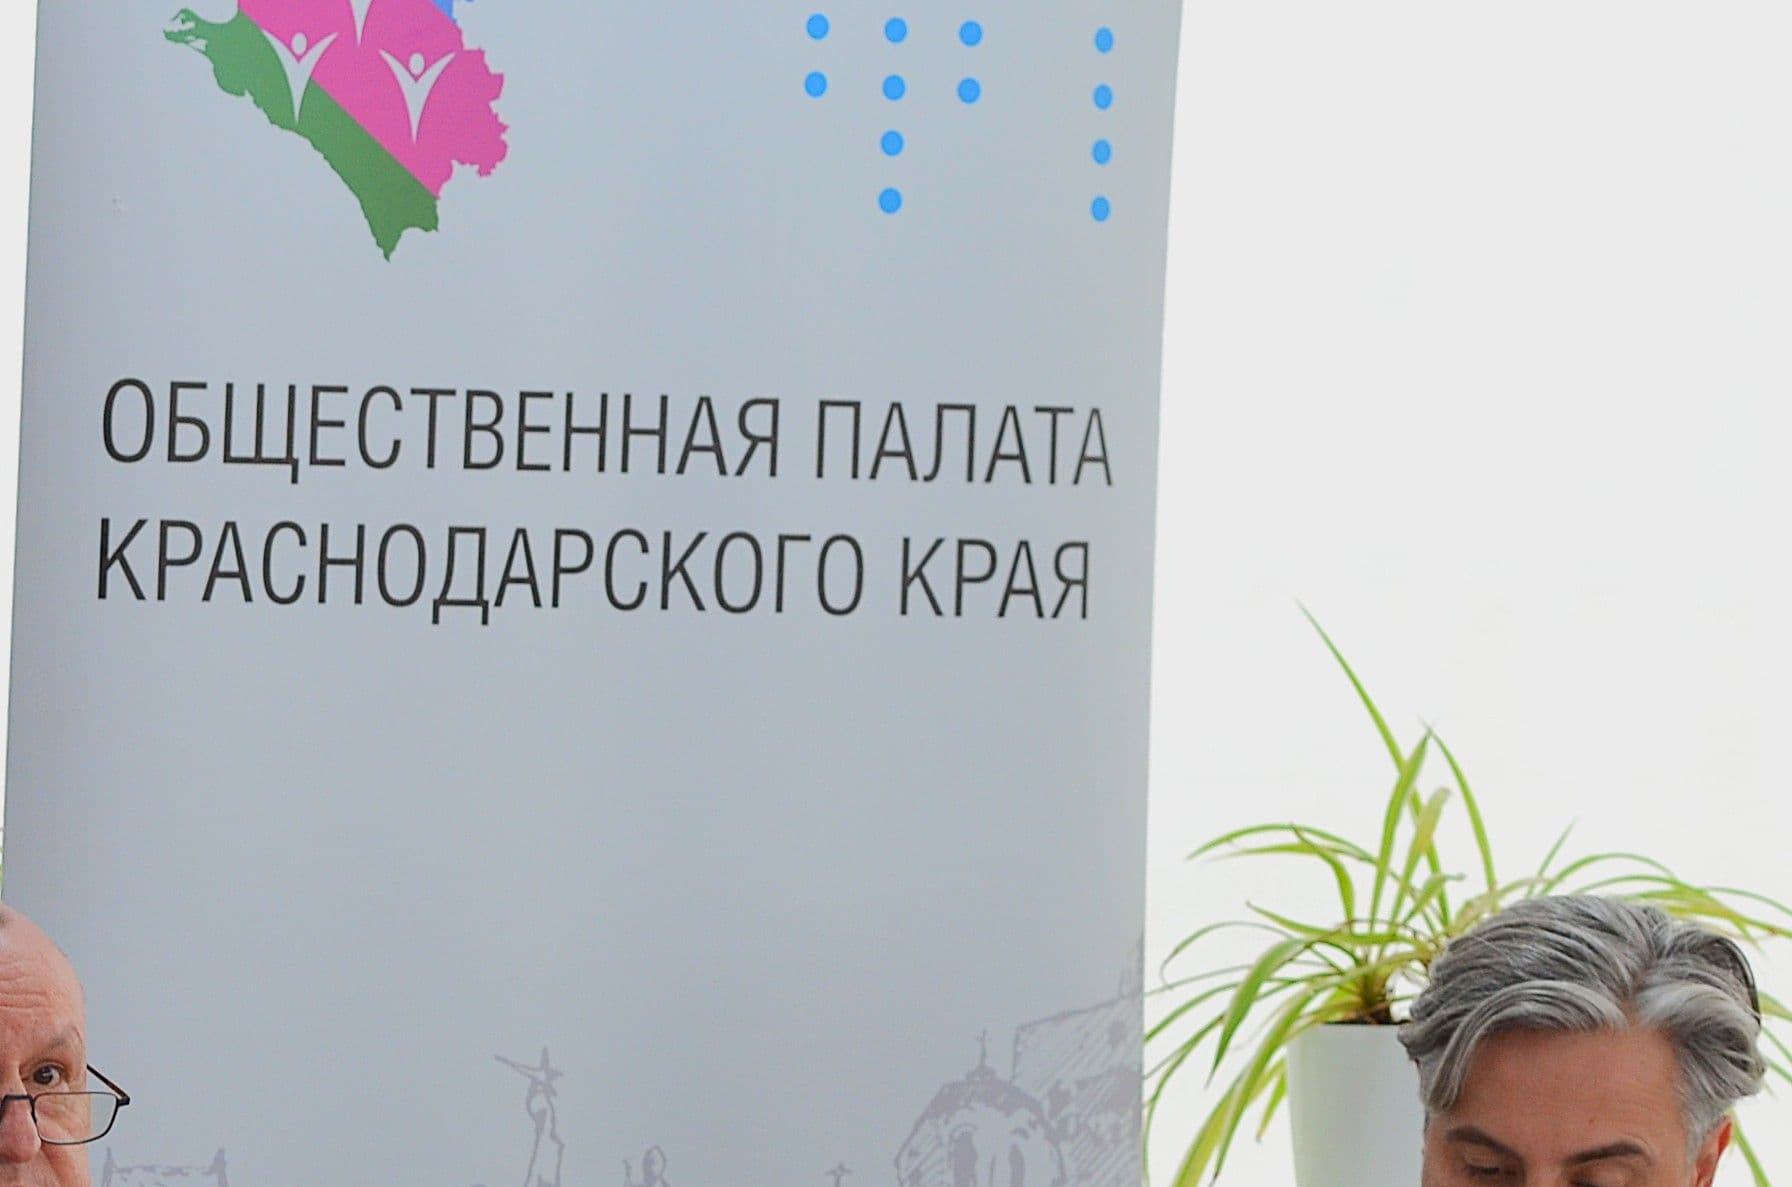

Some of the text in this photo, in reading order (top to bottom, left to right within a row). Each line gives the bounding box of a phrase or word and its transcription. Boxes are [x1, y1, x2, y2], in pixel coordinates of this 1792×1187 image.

[102, 378, 1113, 487] ОБЩЕСТВЕННАЯ ПАЛАТА
[97, 517, 1090, 626] КРАСНОДАРСКОГО КРАЯ
